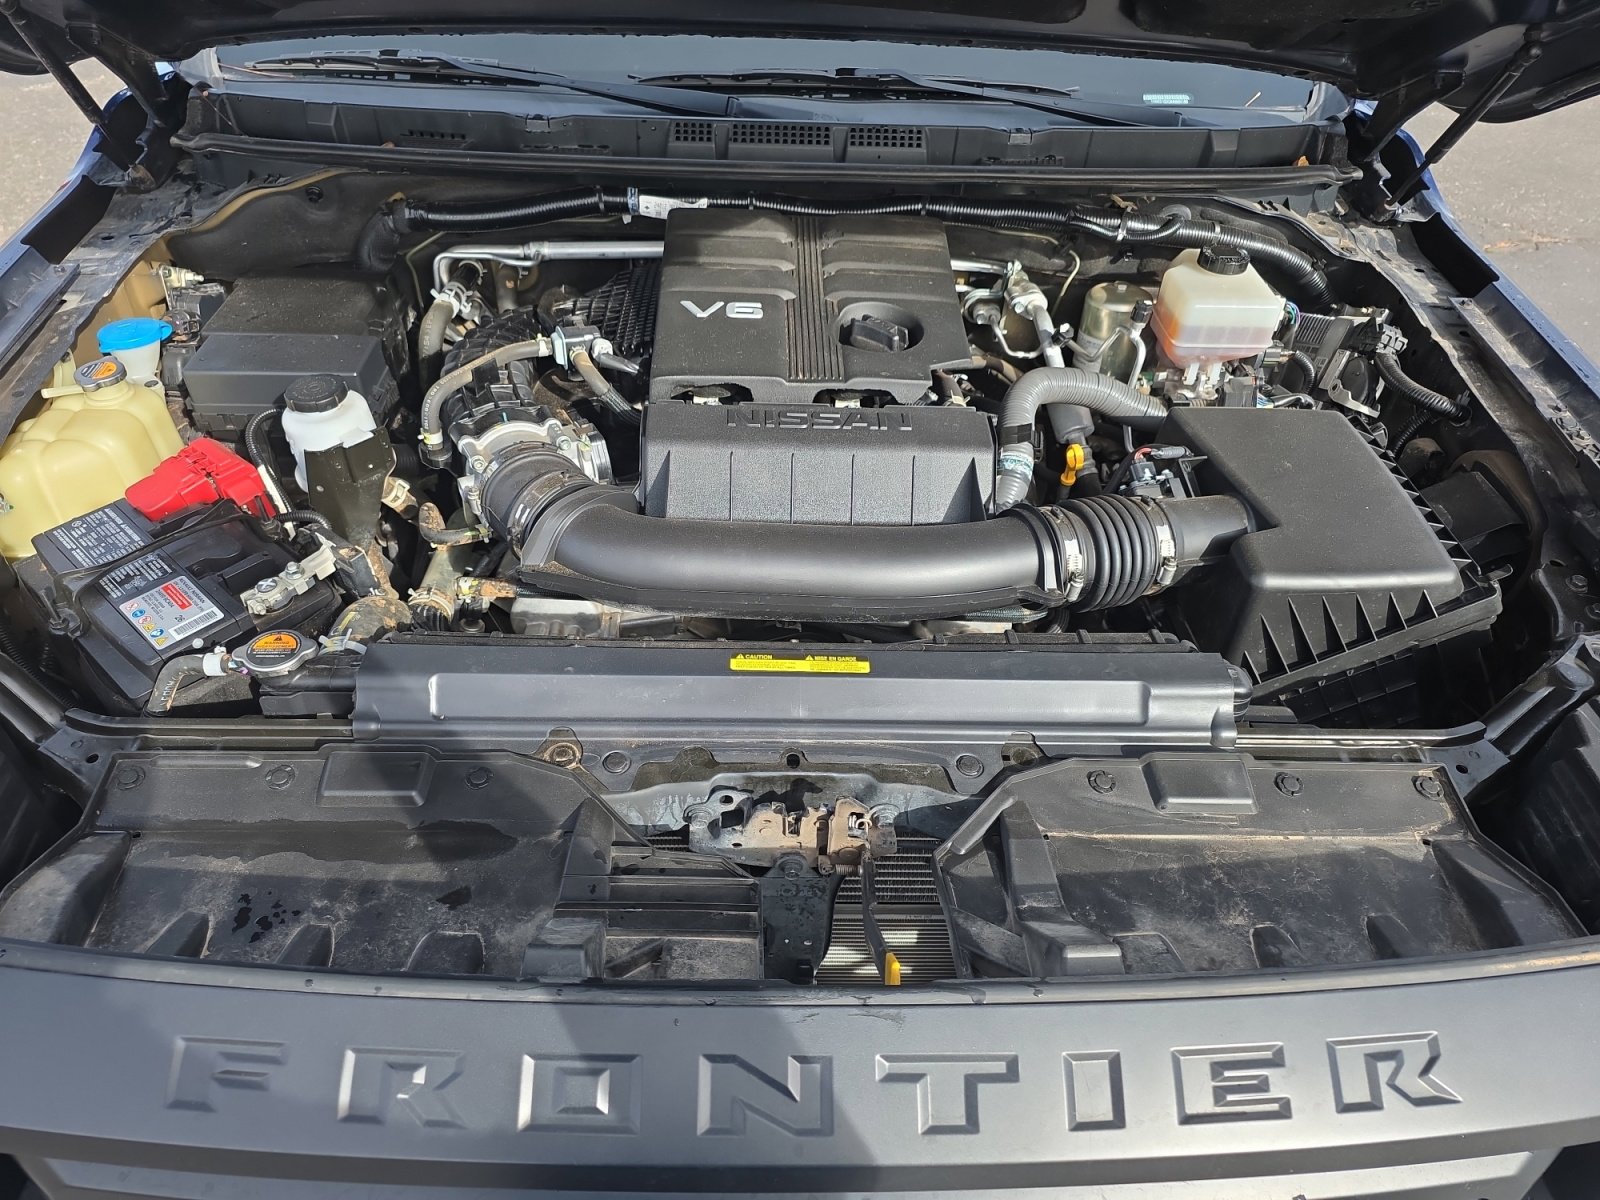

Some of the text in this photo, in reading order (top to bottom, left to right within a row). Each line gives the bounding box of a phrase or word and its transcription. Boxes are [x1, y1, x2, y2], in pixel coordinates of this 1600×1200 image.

[680, 300, 764, 319] V6
[726, 408, 913, 432] NISSAN
[167, 1030, 1464, 1137] FRONTIER
